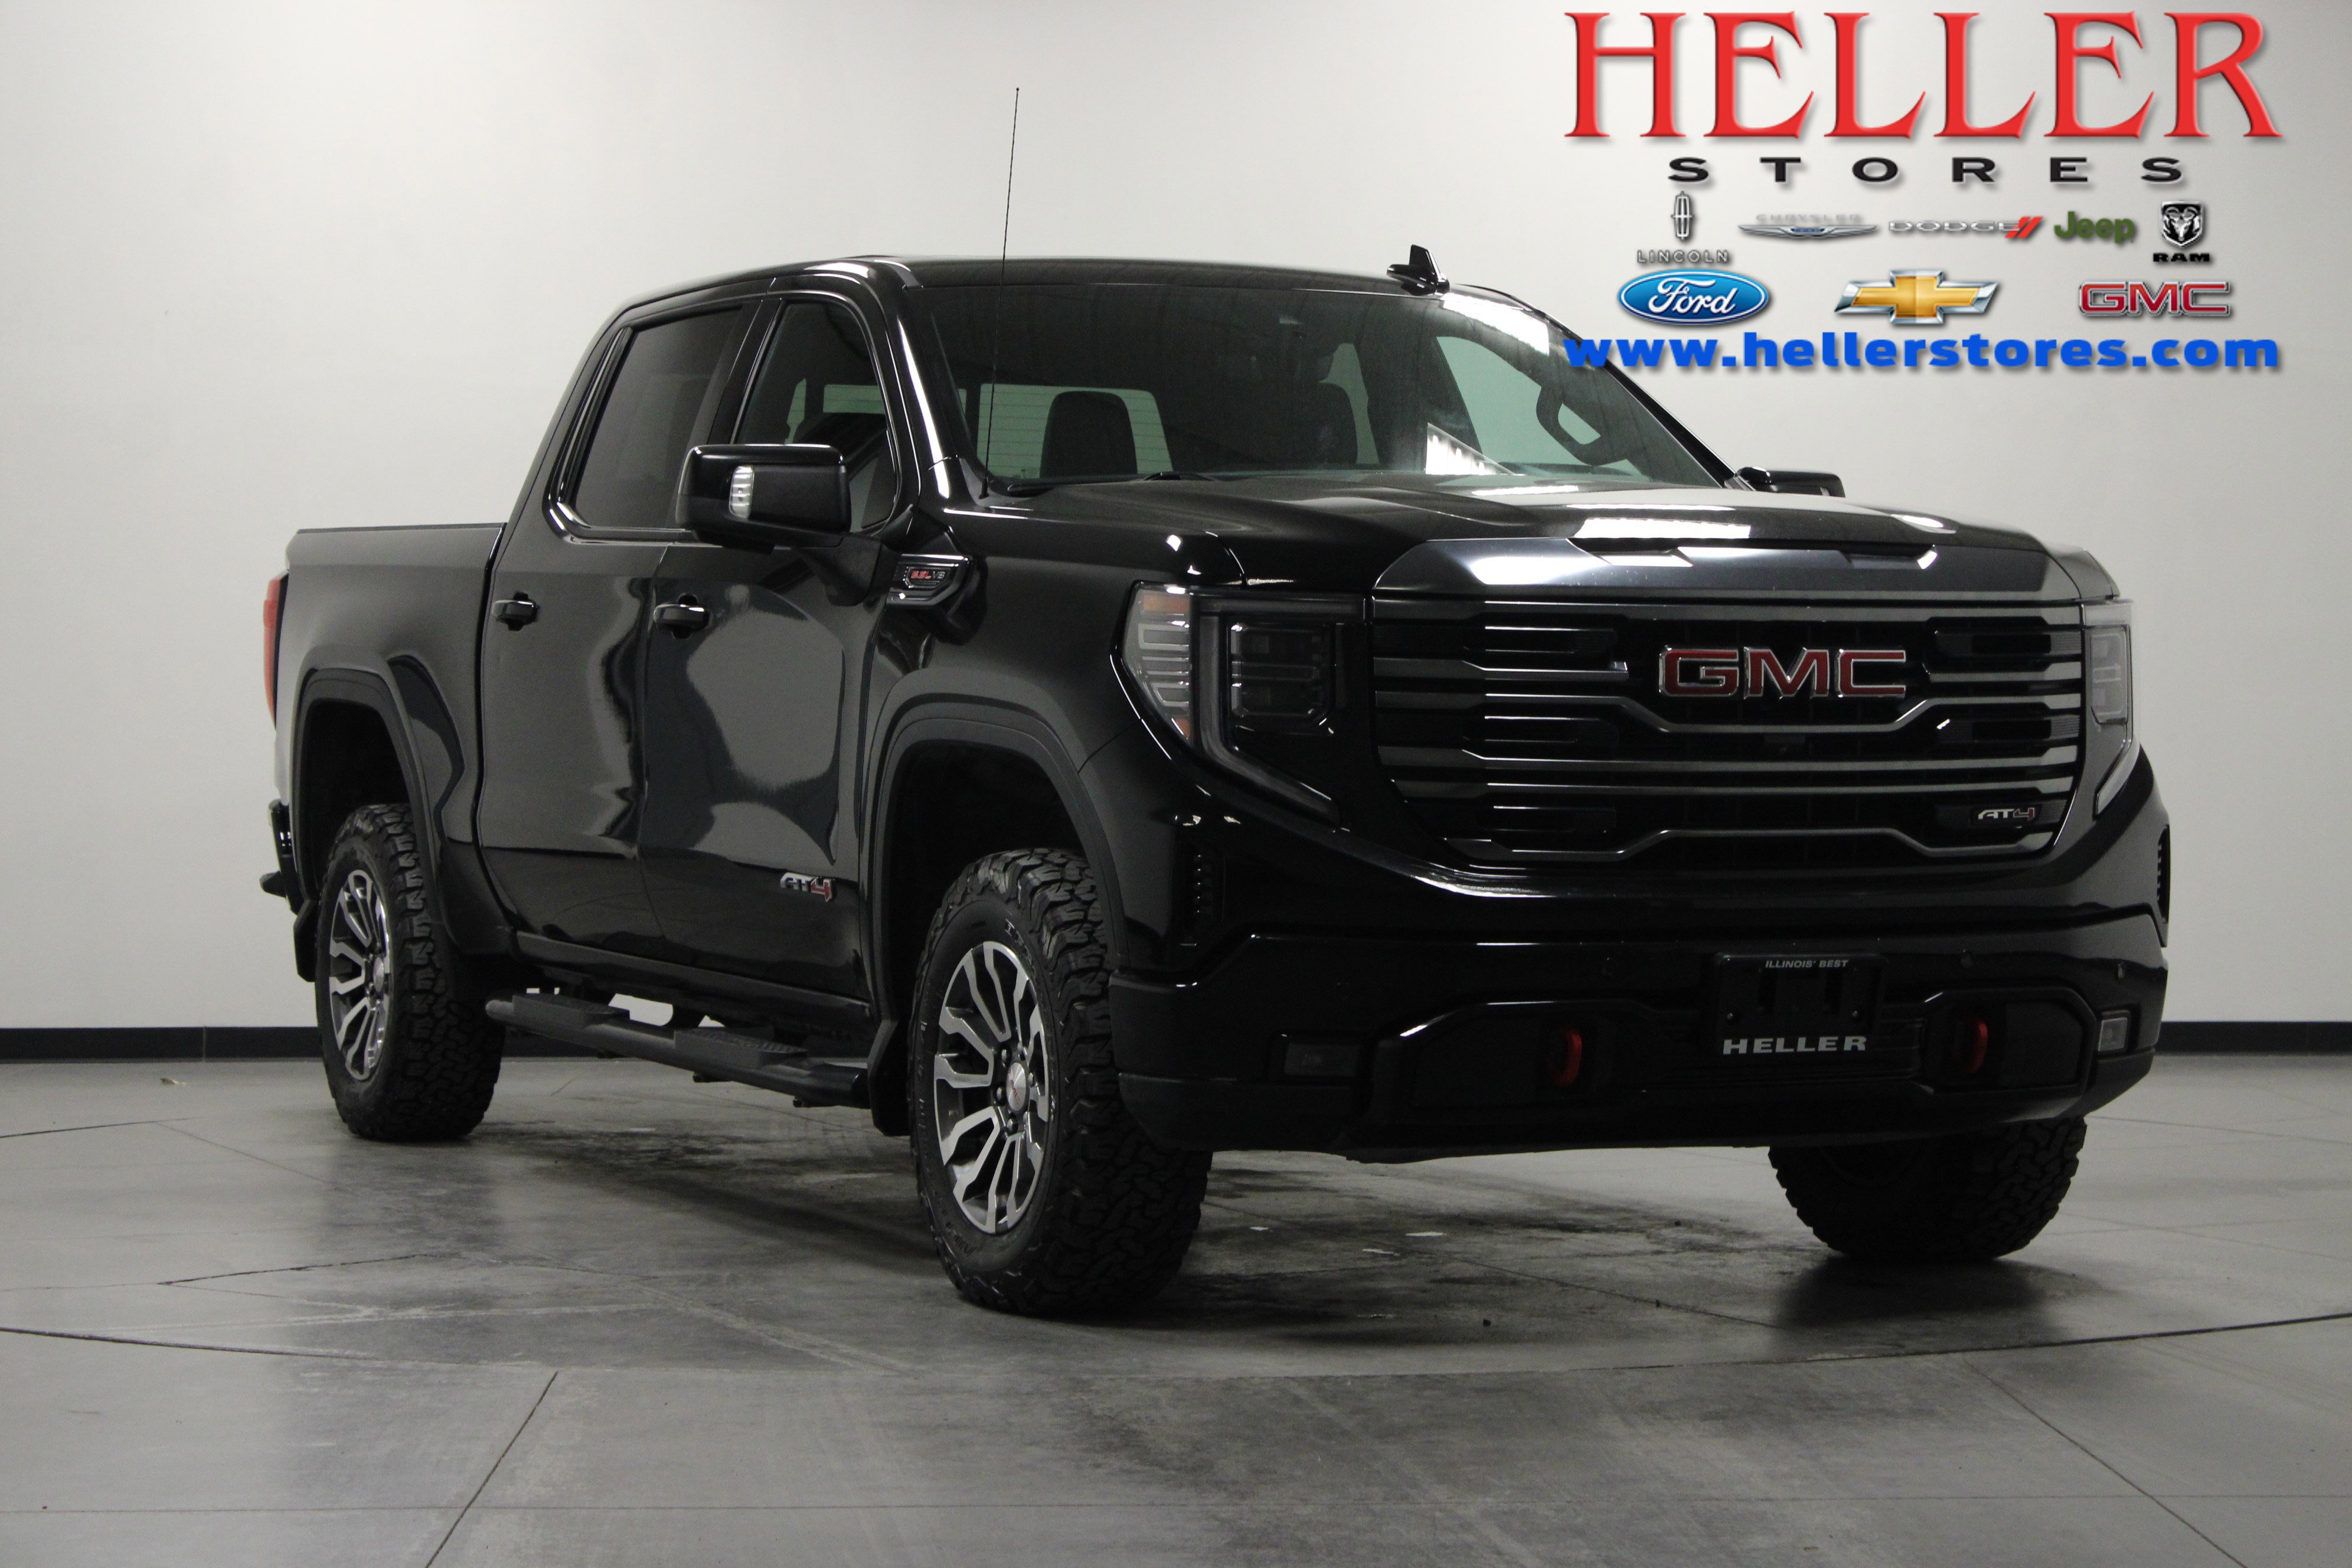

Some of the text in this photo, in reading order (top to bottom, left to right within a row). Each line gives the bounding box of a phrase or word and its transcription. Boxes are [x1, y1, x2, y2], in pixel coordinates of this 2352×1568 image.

[1658, 646, 1906, 699] GMC
[1978, 807, 2035, 821] AT4
[780, 872, 833, 902] AT4
[1765, 959, 1848, 968] ILLINOIS' BEST
[1723, 1035, 1867, 1055] HELLER
